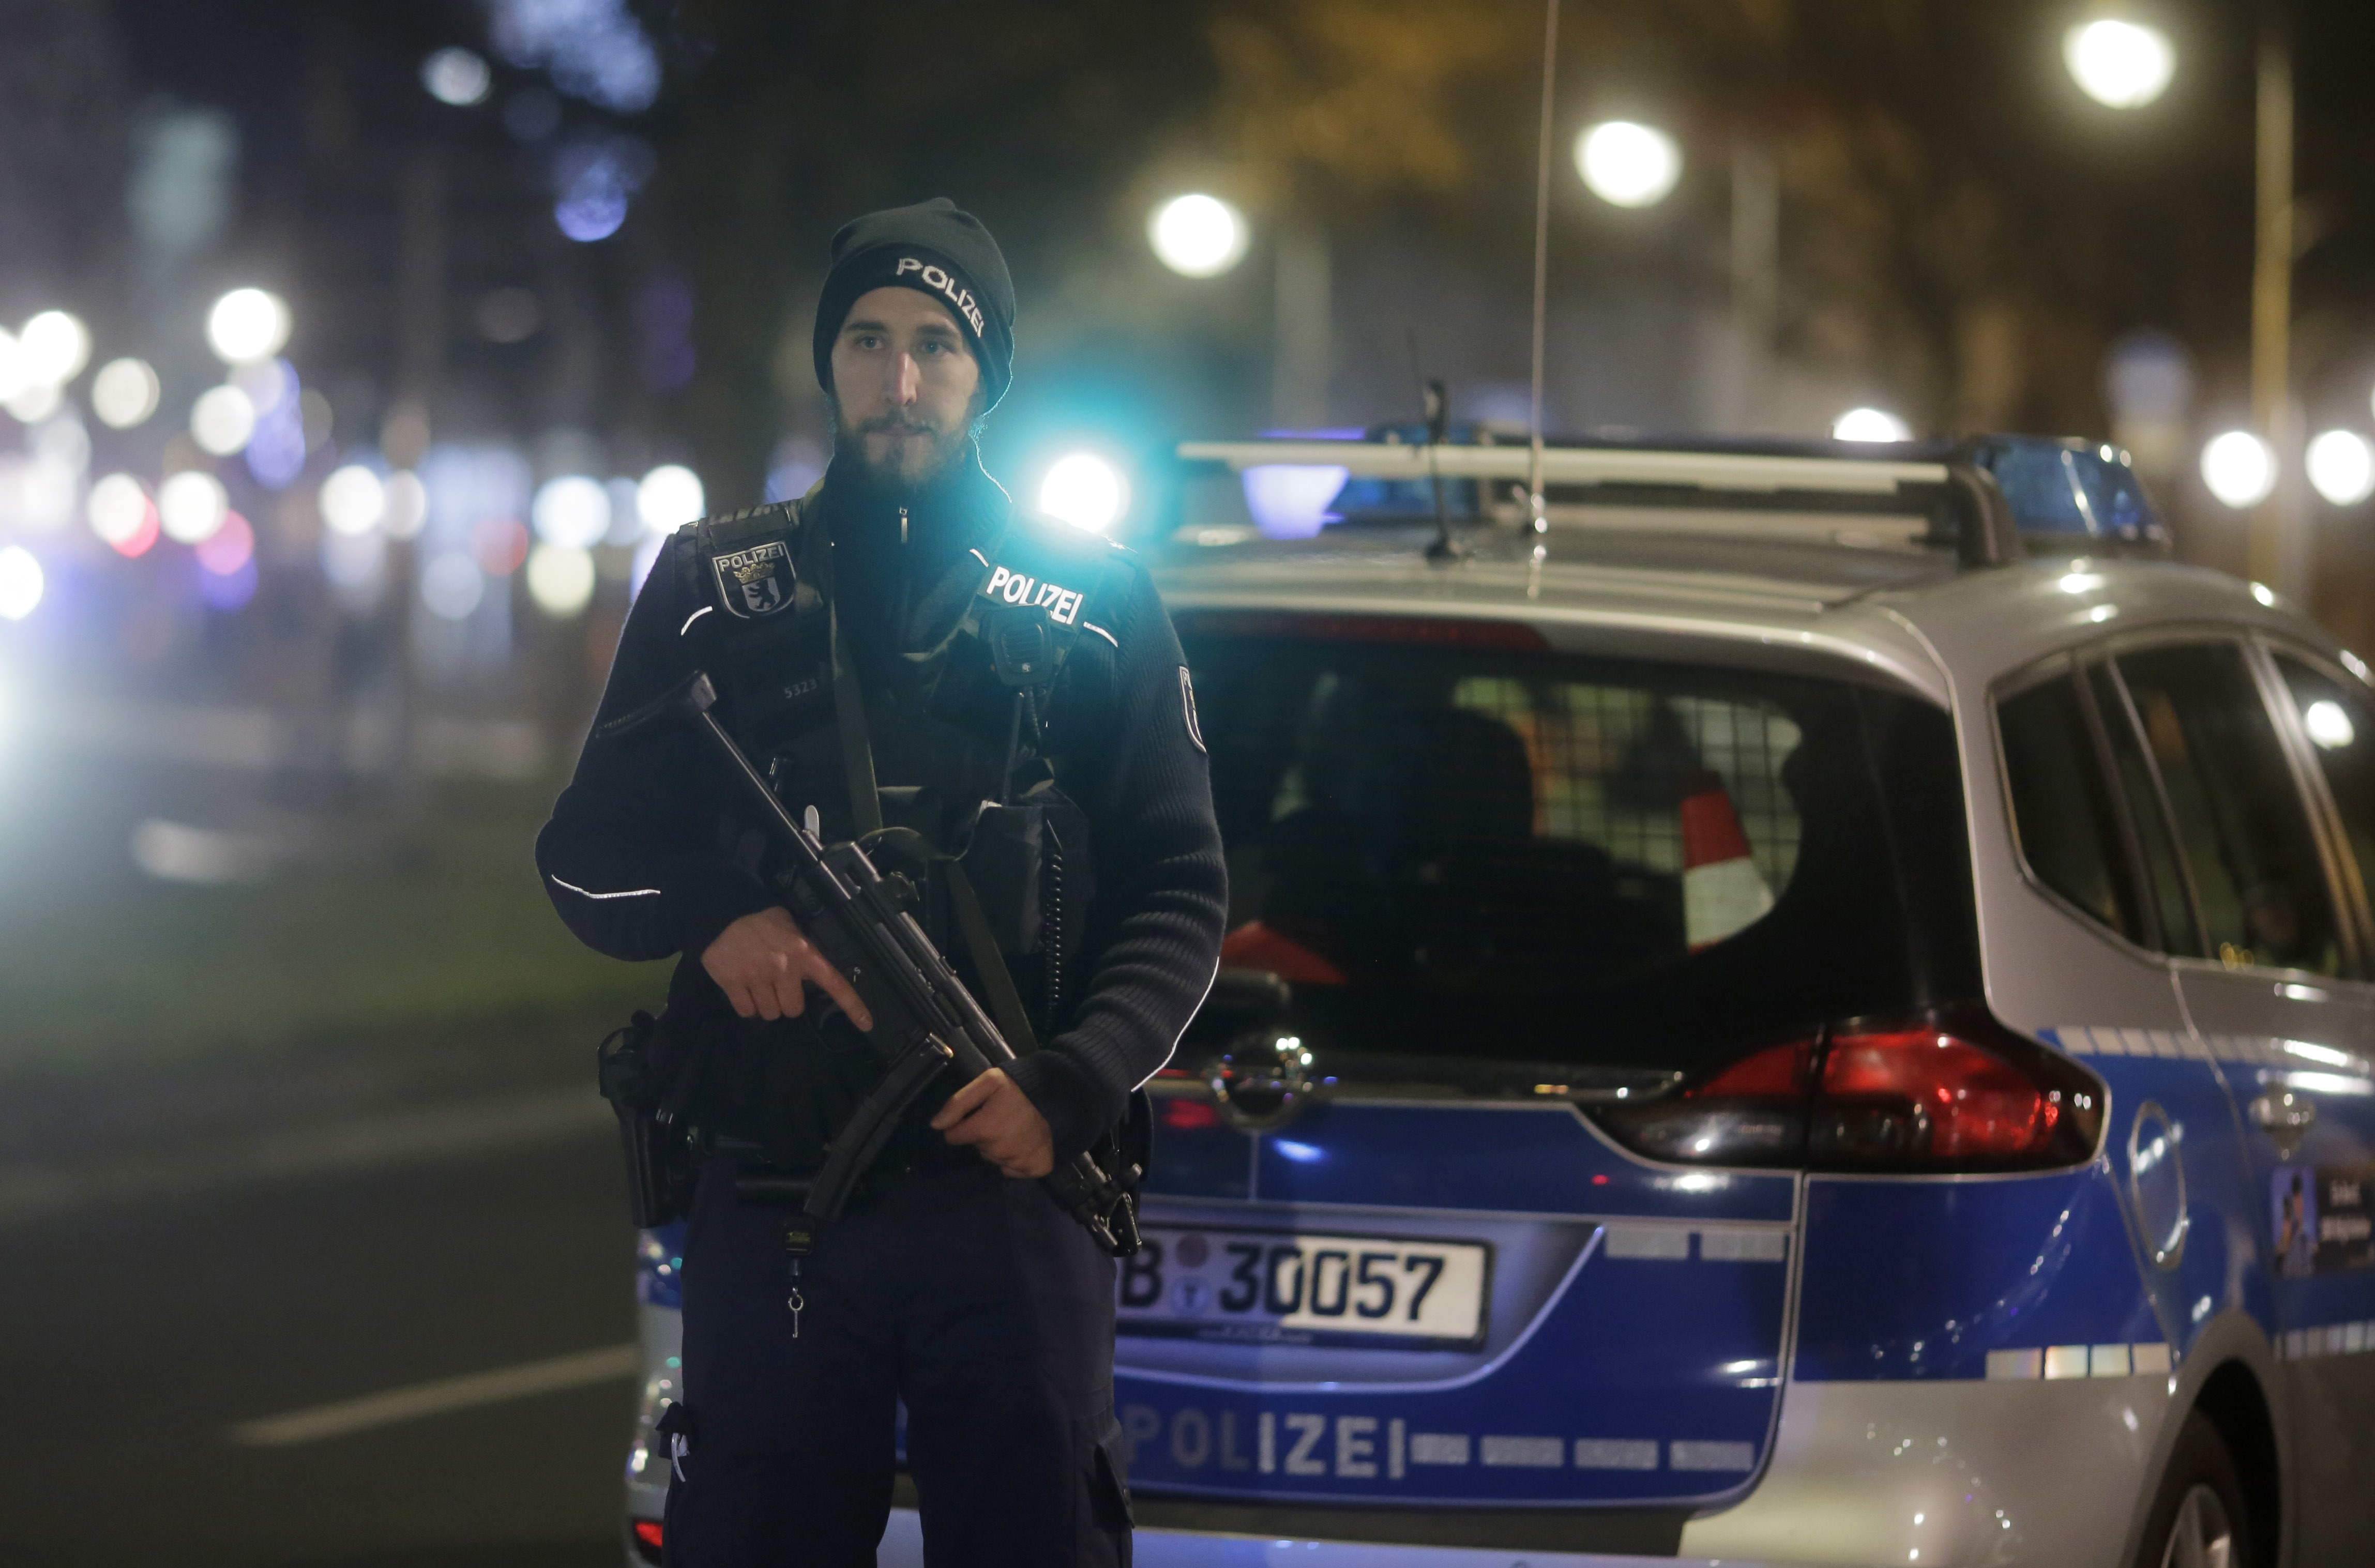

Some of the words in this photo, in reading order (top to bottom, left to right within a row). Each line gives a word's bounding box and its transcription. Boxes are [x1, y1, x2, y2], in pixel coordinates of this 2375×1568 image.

[896, 258, 984, 338] POLIZEI
[718, 545, 784, 572] POLIZEI
[986, 566, 1084, 625] POLIZEI
[784, 678, 817, 699] 5323
[1122, 1240, 1162, 1308] B
[1220, 1242, 1445, 1320] 30057
[1121, 1403, 1406, 1480] POLIZEI
